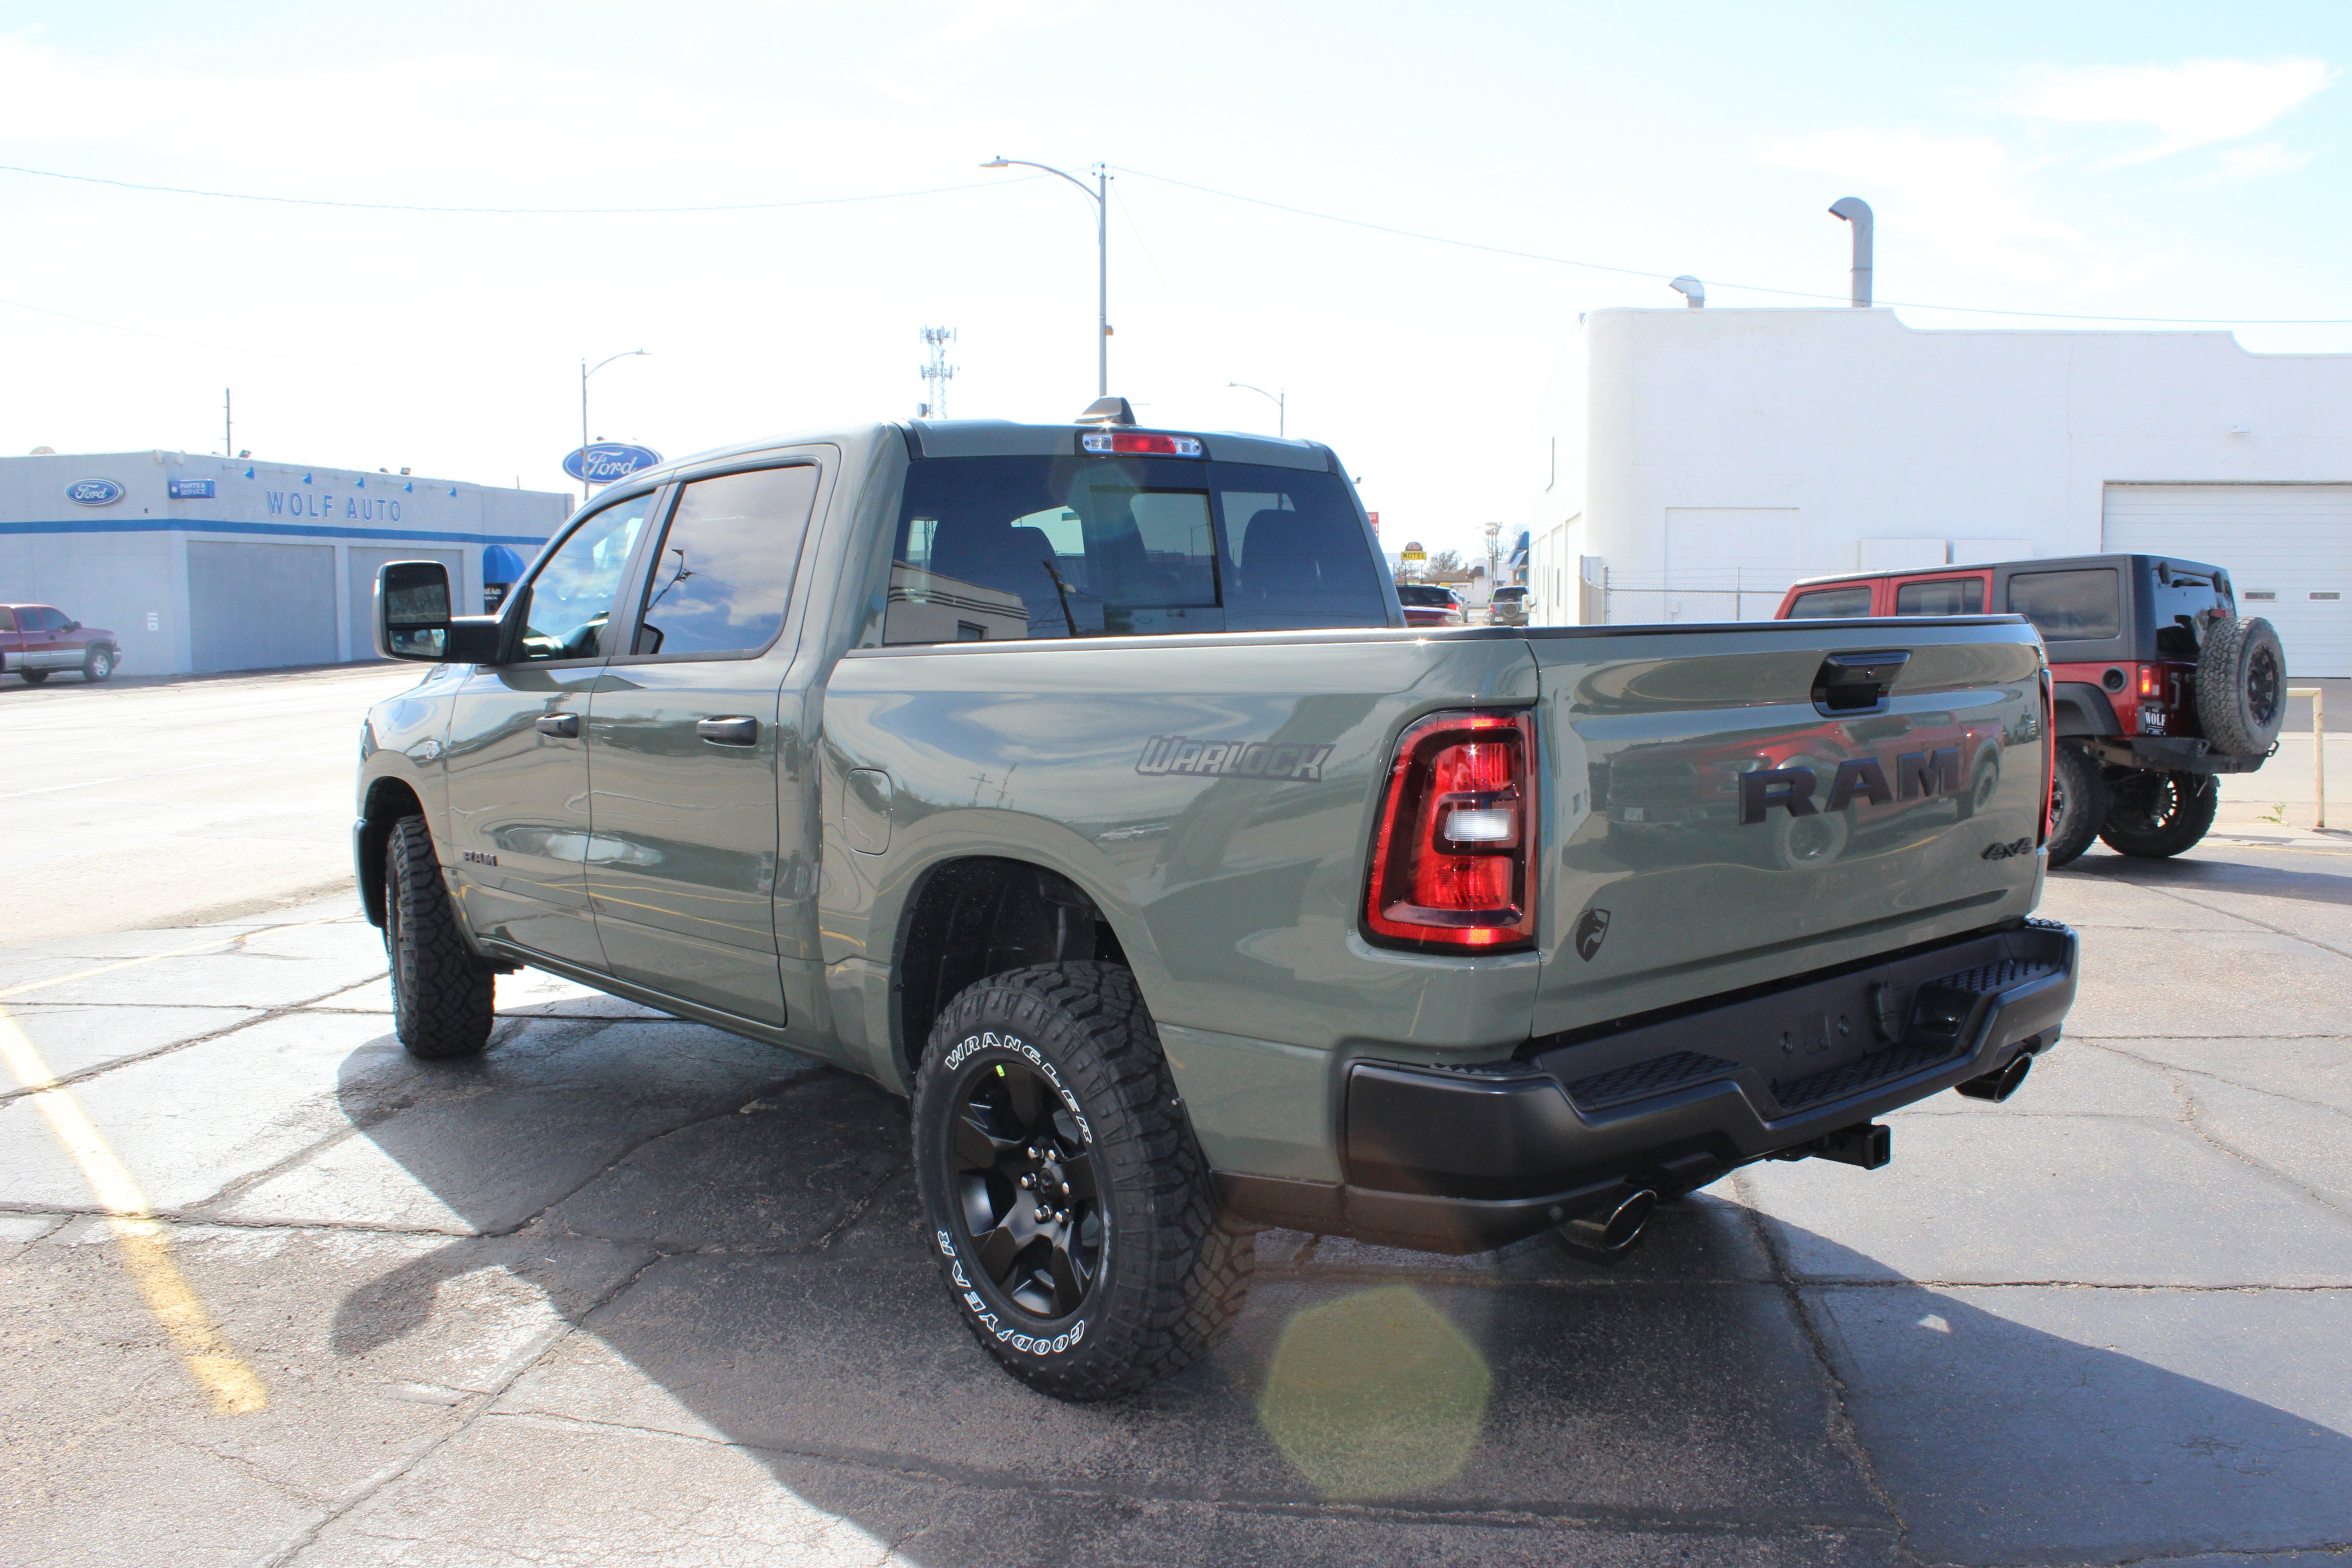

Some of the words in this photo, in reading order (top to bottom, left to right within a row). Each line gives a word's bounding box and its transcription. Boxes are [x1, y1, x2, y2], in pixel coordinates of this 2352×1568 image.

[582, 451, 637, 475] Ford
[75, 484, 107, 499] Ford
[266, 490, 333, 519] WOLF
[346, 497, 402, 523] AUTO
[2145, 712, 2166, 726] WOLF
[1135, 735, 1337, 783] WARLOCK
[1739, 747, 1960, 825] RAM
[463, 850, 498, 867] RAM
[945, 1031, 1093, 1143] WRANGLER
[937, 1230, 1086, 1356] GOODYEAR
